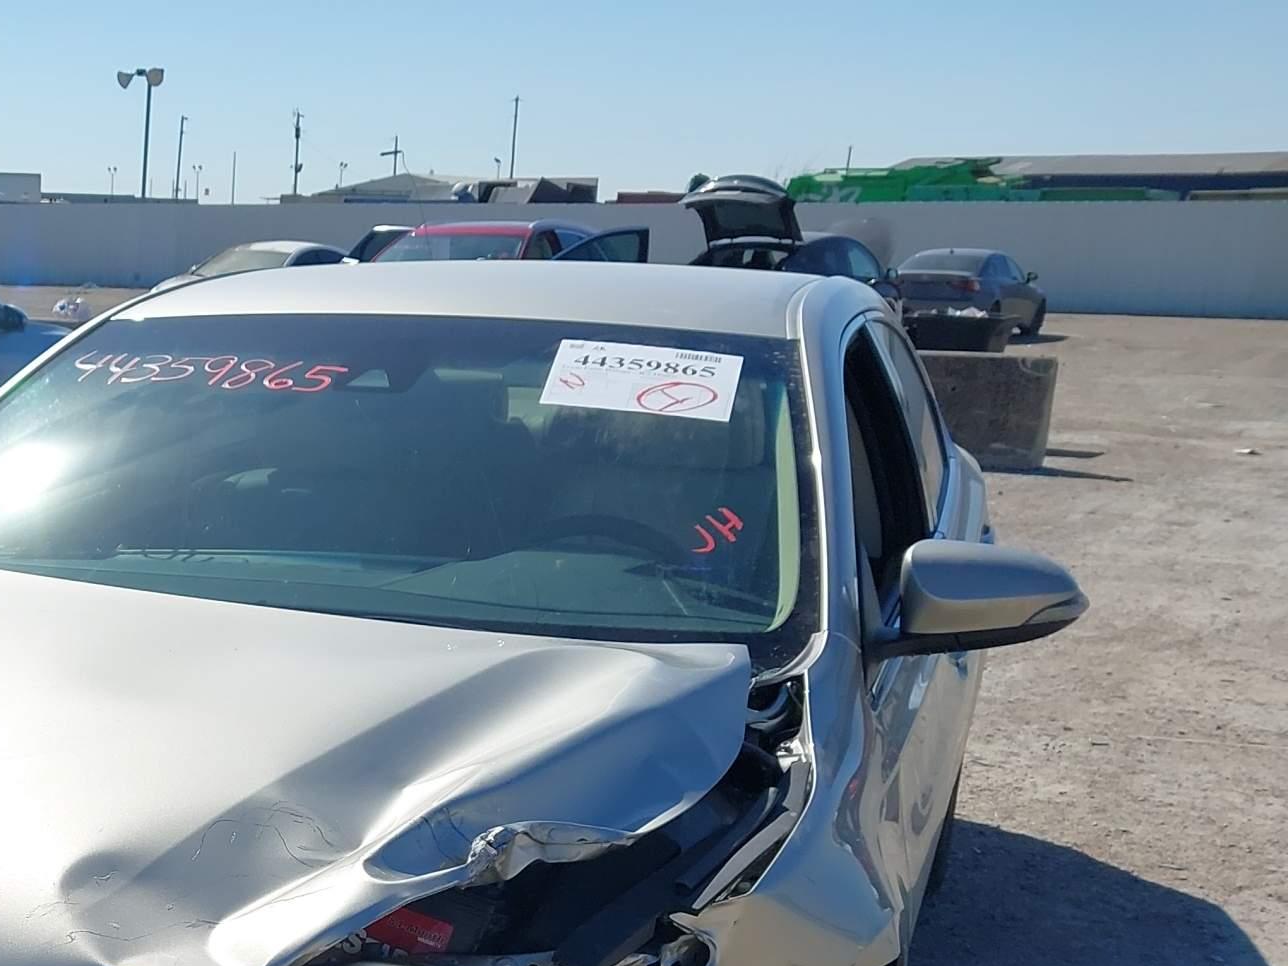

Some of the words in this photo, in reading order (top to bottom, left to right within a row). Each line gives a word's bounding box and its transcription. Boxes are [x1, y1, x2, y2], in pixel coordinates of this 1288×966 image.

[75, 351, 349, 392] 44359865
[574, 354, 717, 378] 44359865
[691, 507, 744, 552] JH
